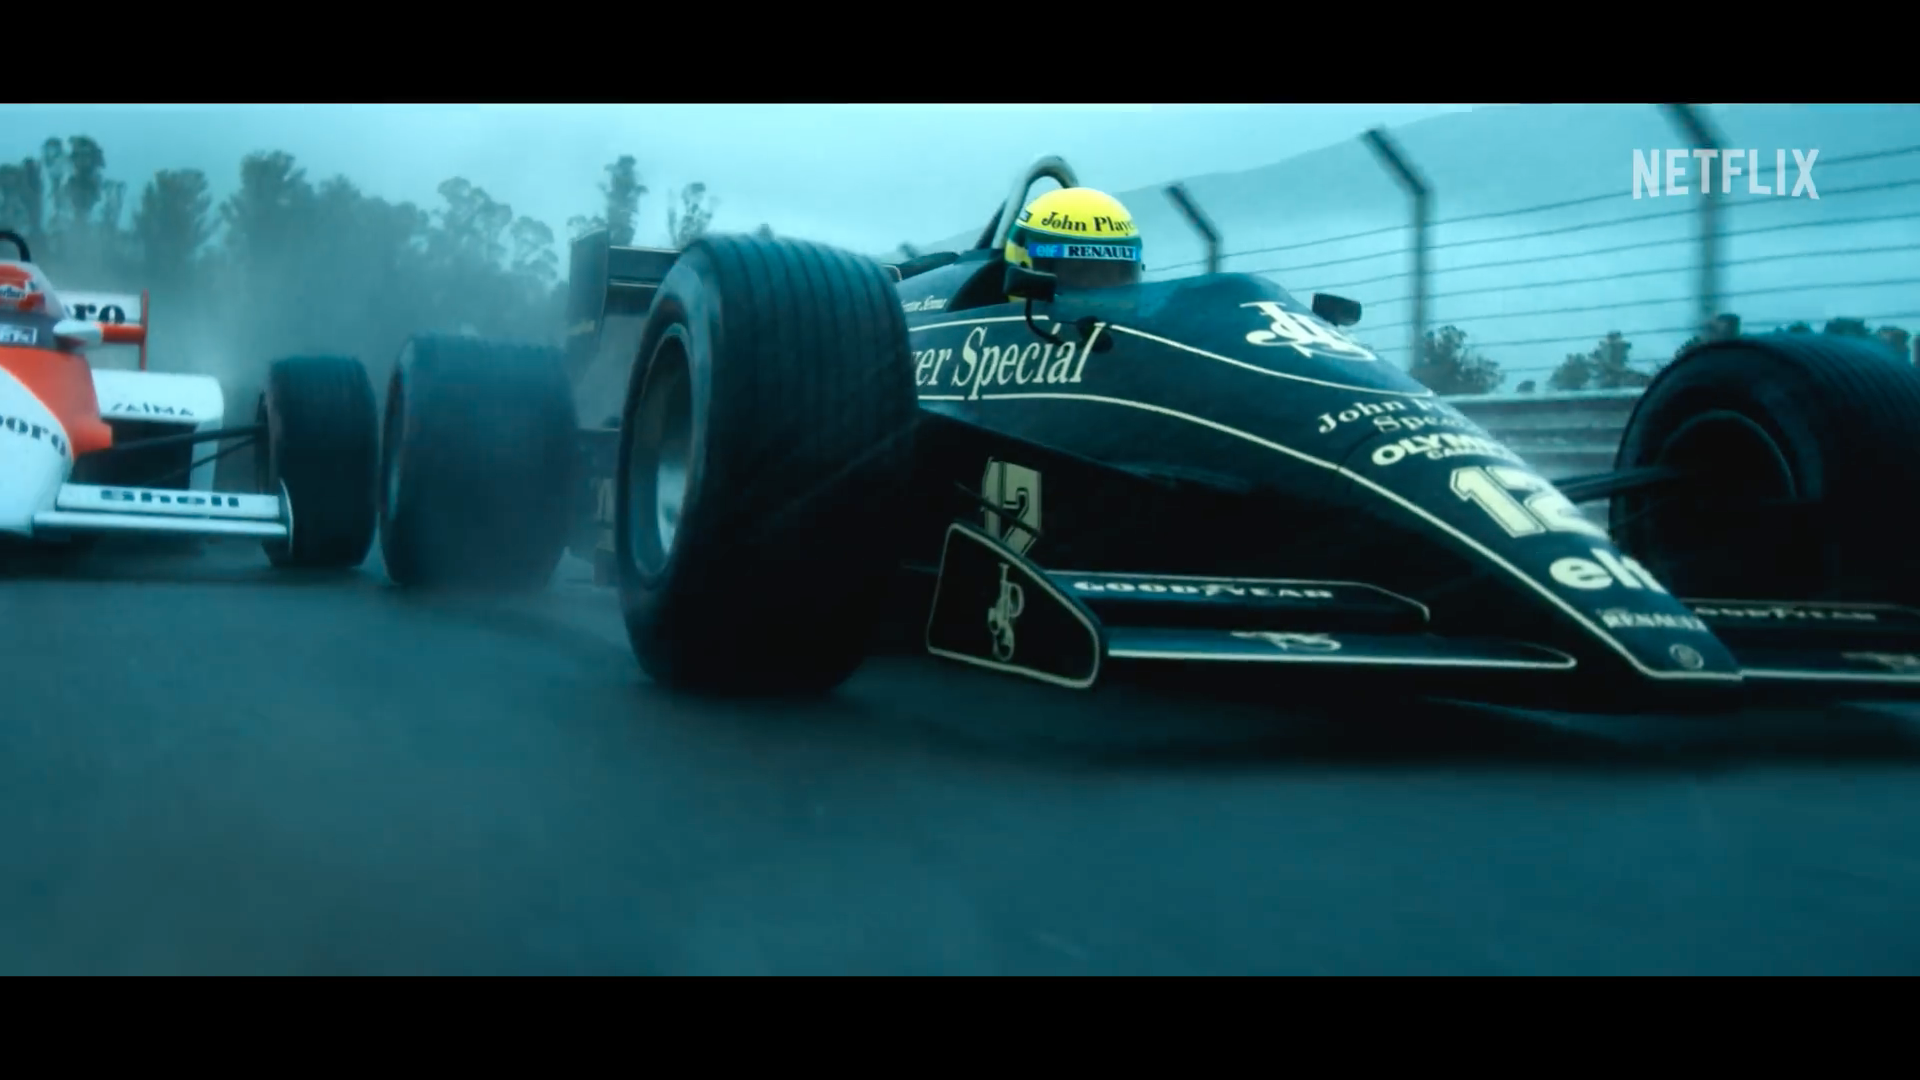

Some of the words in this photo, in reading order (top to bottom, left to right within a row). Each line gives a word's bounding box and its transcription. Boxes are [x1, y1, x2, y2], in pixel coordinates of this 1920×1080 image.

[1041, 211, 1087, 232] John
[1068, 245, 1135, 259] RENAULT
[951, 322, 1107, 400] Special
[1318, 400, 1407, 434] John
[101, 489, 240, 508] Shell
[981, 457, 1043, 557] 12
[1450, 465, 1612, 539] 12
[1073, 581, 1334, 599] GOODYEAR
